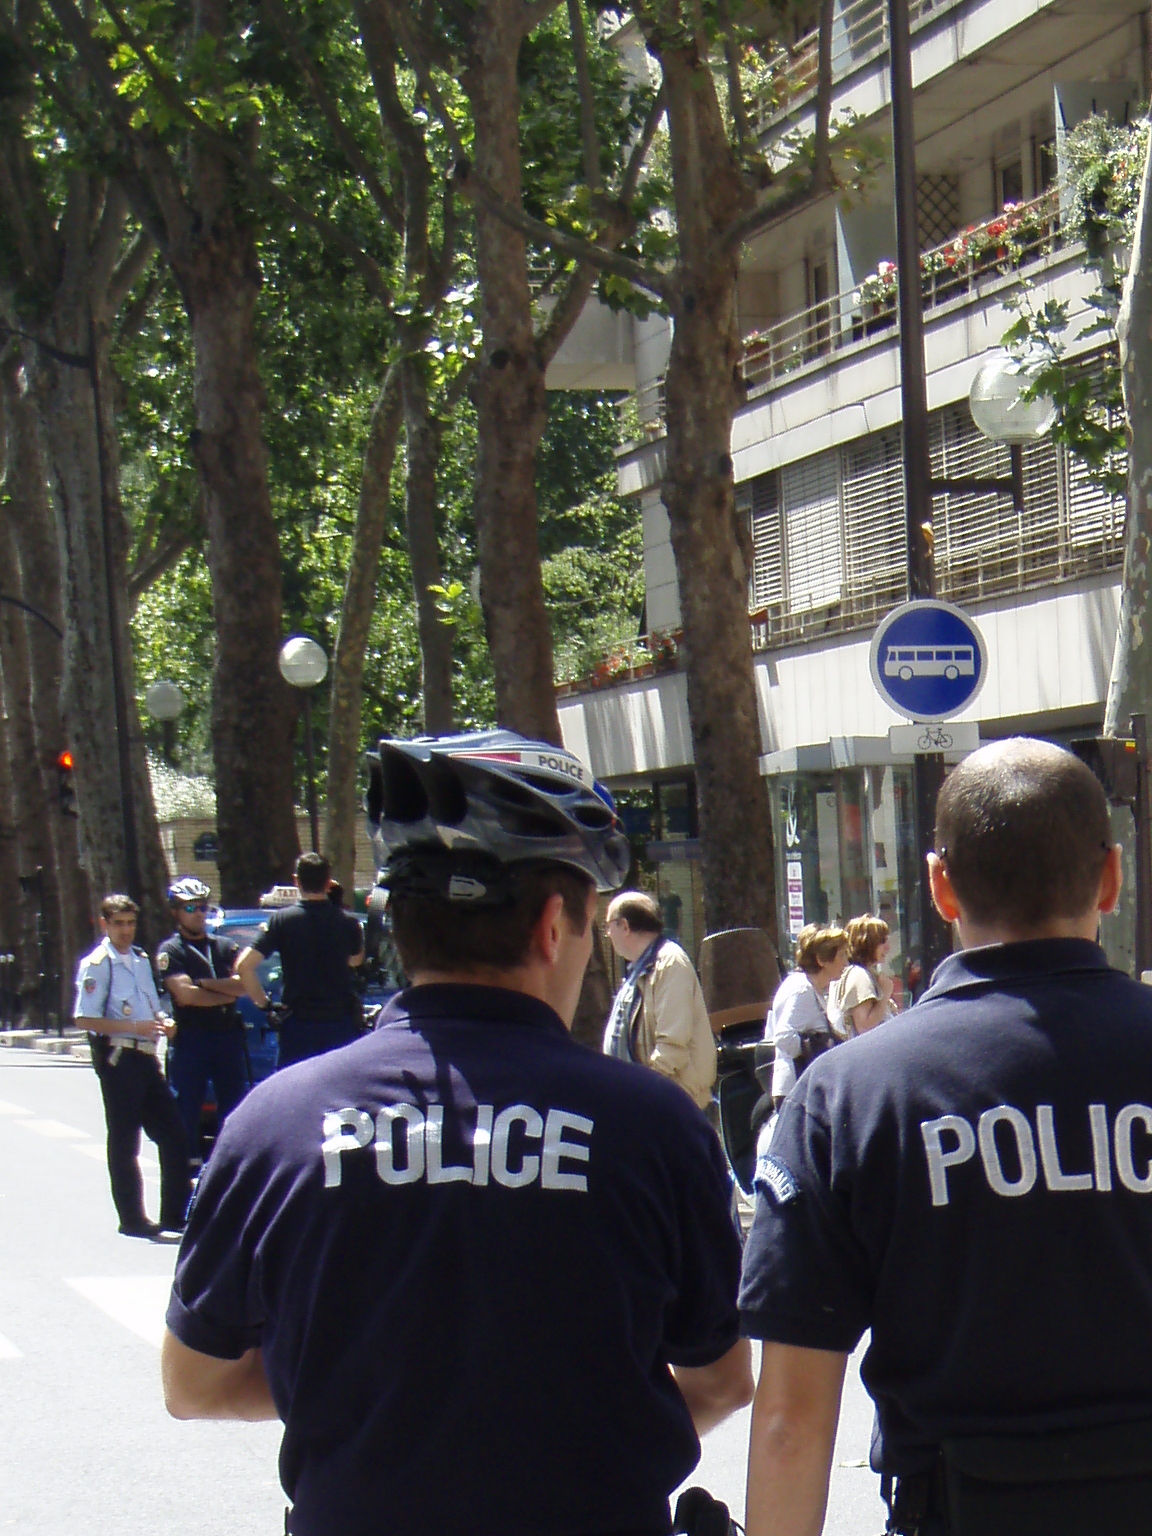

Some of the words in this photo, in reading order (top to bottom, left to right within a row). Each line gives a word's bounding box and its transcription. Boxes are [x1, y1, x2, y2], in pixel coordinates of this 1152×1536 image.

[538, 754, 584, 781] POLICE
[277, 888, 298, 898] TAXI
[320, 1102, 595, 1194] POLICE
